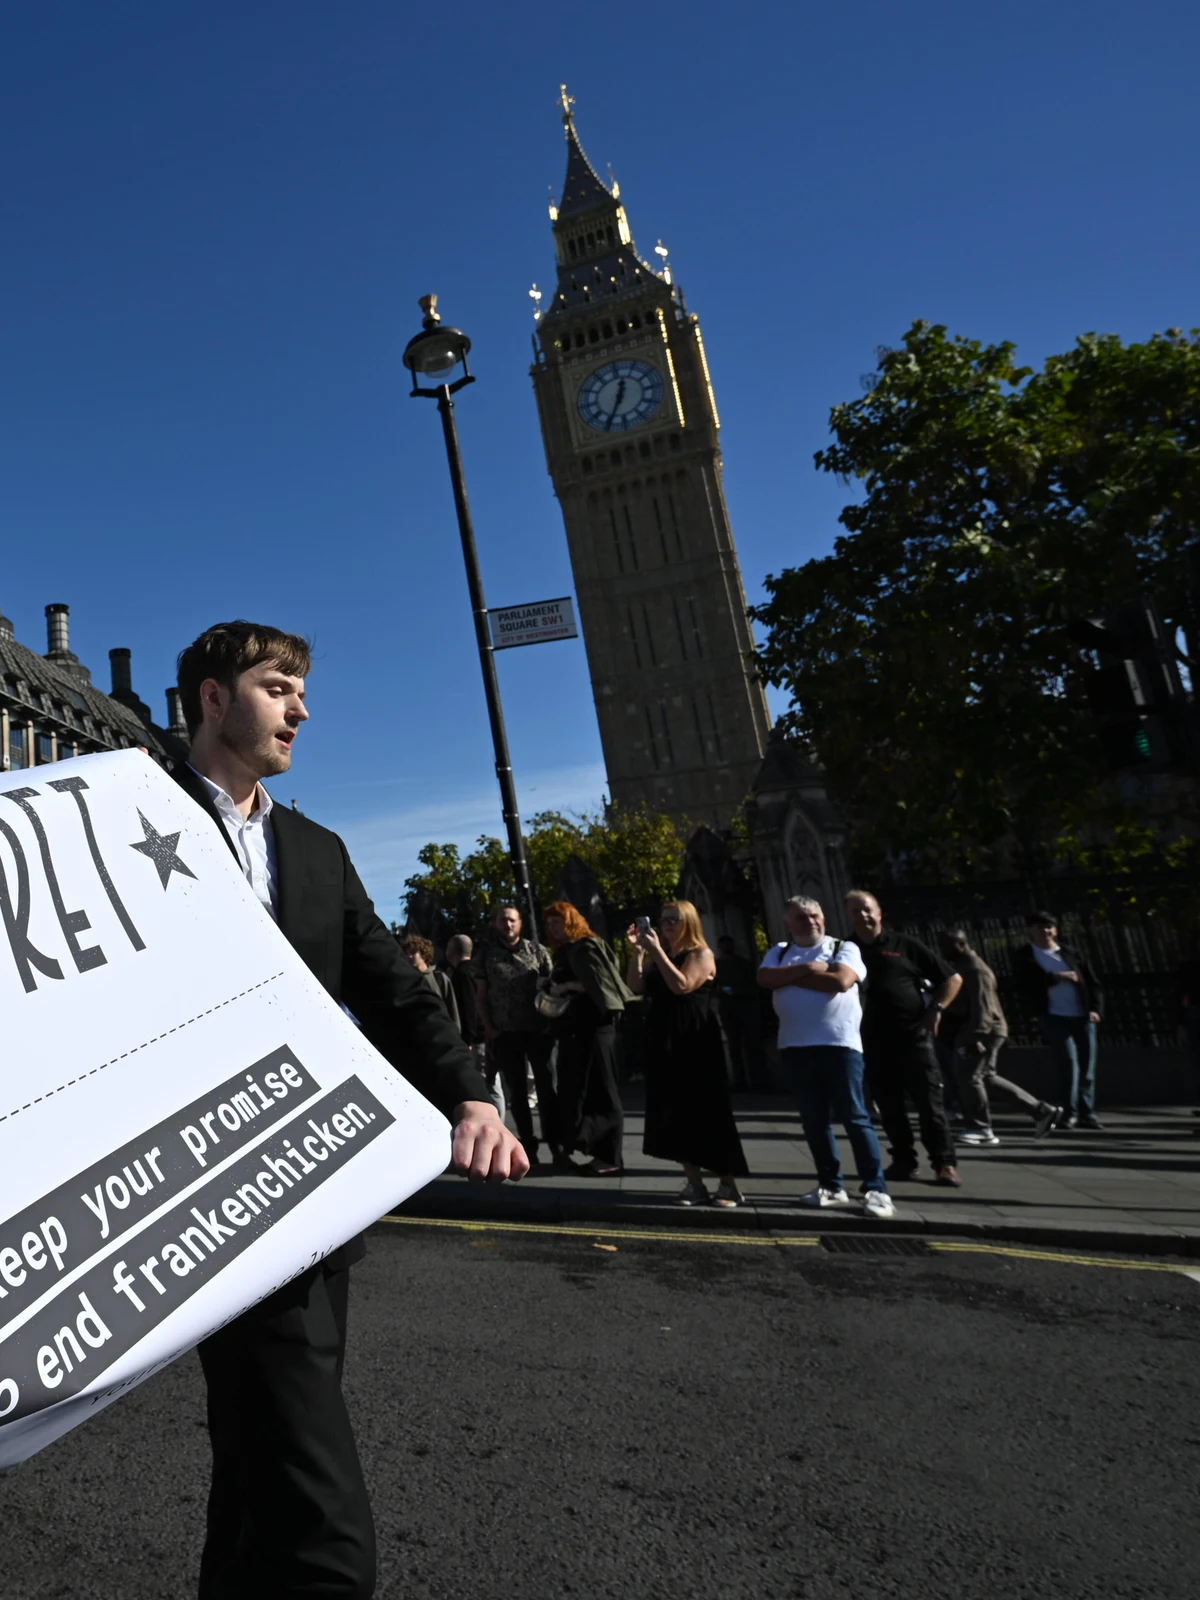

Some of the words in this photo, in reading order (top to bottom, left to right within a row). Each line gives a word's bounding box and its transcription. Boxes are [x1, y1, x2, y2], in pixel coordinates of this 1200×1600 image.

[497, 604, 560, 622] PARLIAMENT
[499, 619, 539, 633] SQUARE
[541, 615, 564, 626] SW1
[80, 1146, 166, 1240] your
[179, 1062, 303, 1167] promise
[36, 1291, 113, 1389] end
[112, 1101, 377, 1313] frankenchicken.
